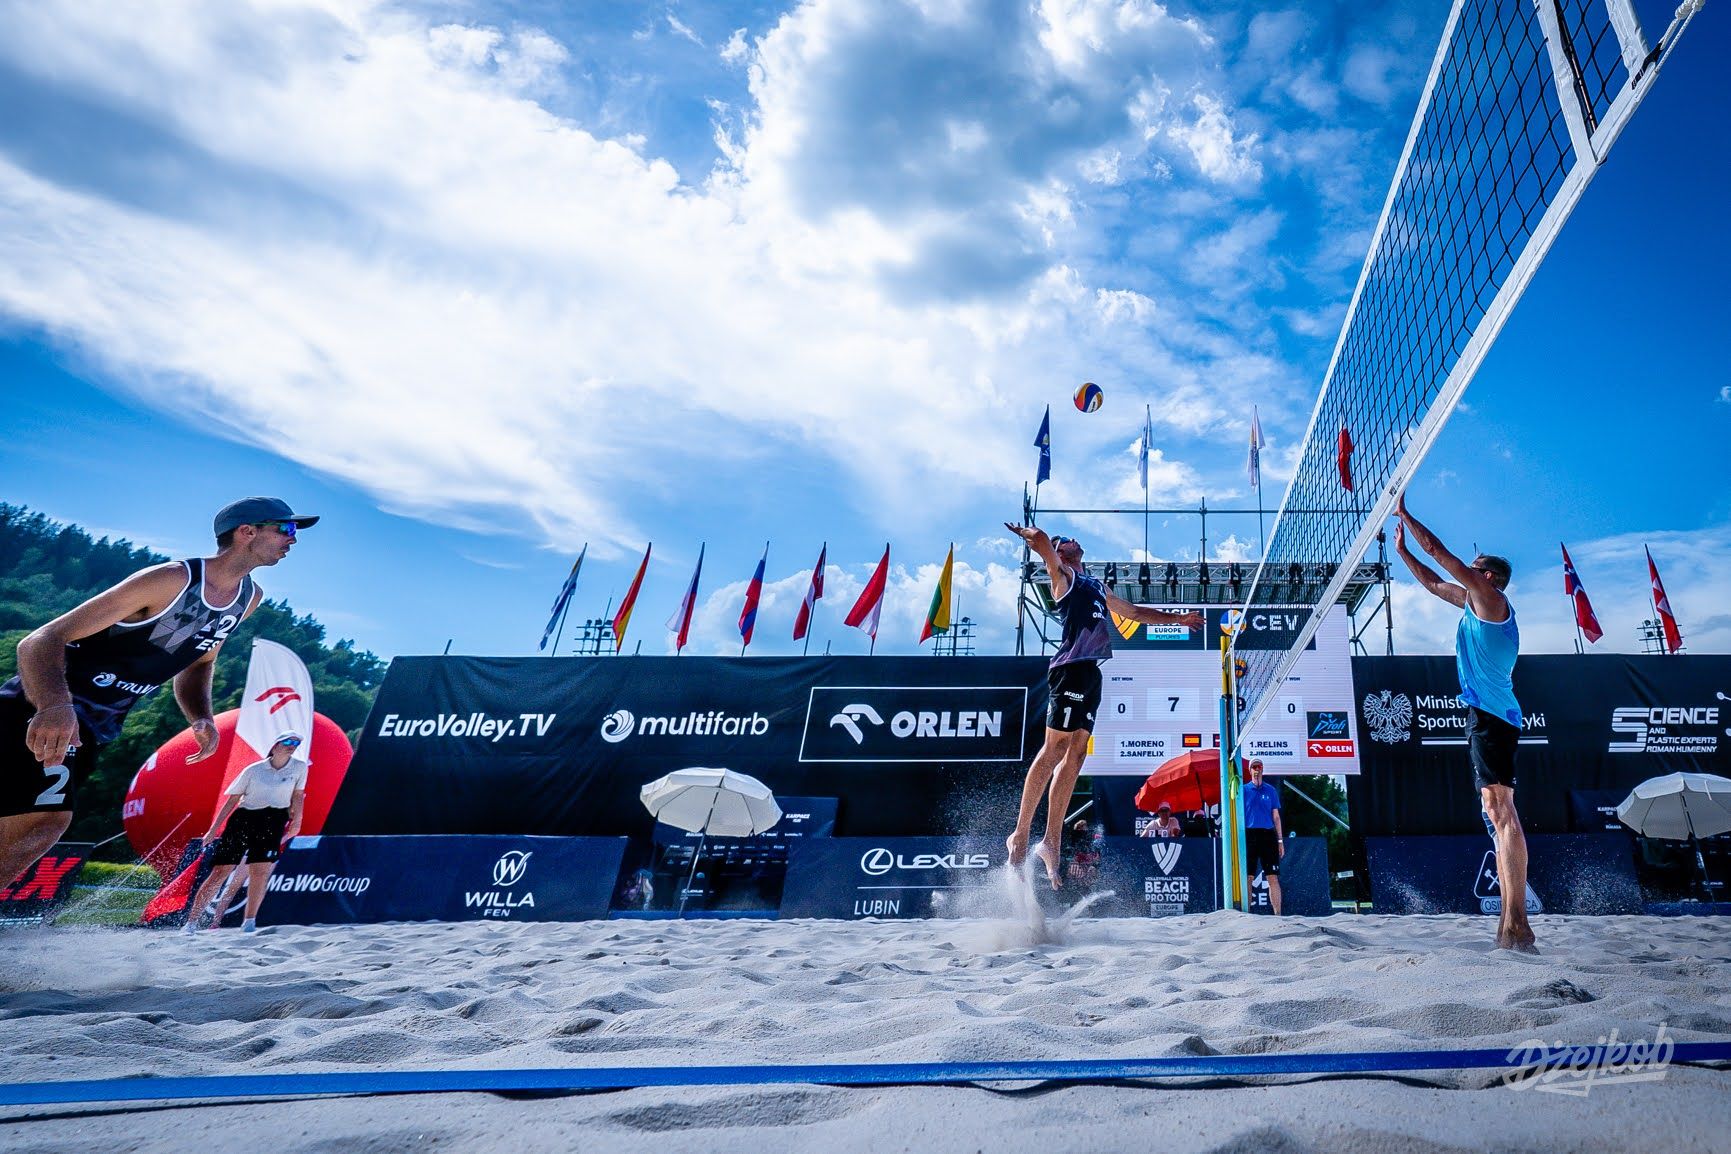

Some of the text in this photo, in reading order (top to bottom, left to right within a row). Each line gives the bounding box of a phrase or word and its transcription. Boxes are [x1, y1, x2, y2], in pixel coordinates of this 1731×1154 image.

[214, 614, 237, 639] 2
[1252, 614, 1299, 631] CEV
[1117, 703, 1126, 714] 0
[1167, 696, 1180, 712] 7
[1287, 702, 1296, 714] 0
[637, 710, 769, 736] multifarb
[890, 710, 1003, 738] ORLEN
[1063, 705, 1073, 729] 1
[1417, 714, 1467, 731] Sportu
[378, 713, 556, 743] EuroVolley.TV
[1608, 707, 1719, 752] SCIENCE
[1120, 740, 1165, 748] 1.MORENO
[1647, 736, 1718, 744] PLASTIC EXPERTS
[1120, 750, 1165, 758] 2.SANFELIX
[1325, 744, 1353, 753] ORLEN
[1646, 745, 1718, 753] ROMAN HUMIENNY
[35, 764, 70, 806] 2
[896, 853, 990, 869] LEXUS
[266, 874, 371, 896] MaWoGroup
[1144, 881, 1189, 893] BEACH
[465, 891, 535, 908] WILLA
[1145, 893, 1190, 902] PRO TOUR
[483, 908, 511, 917] FEN
[854, 900, 900, 915] LUBIN
